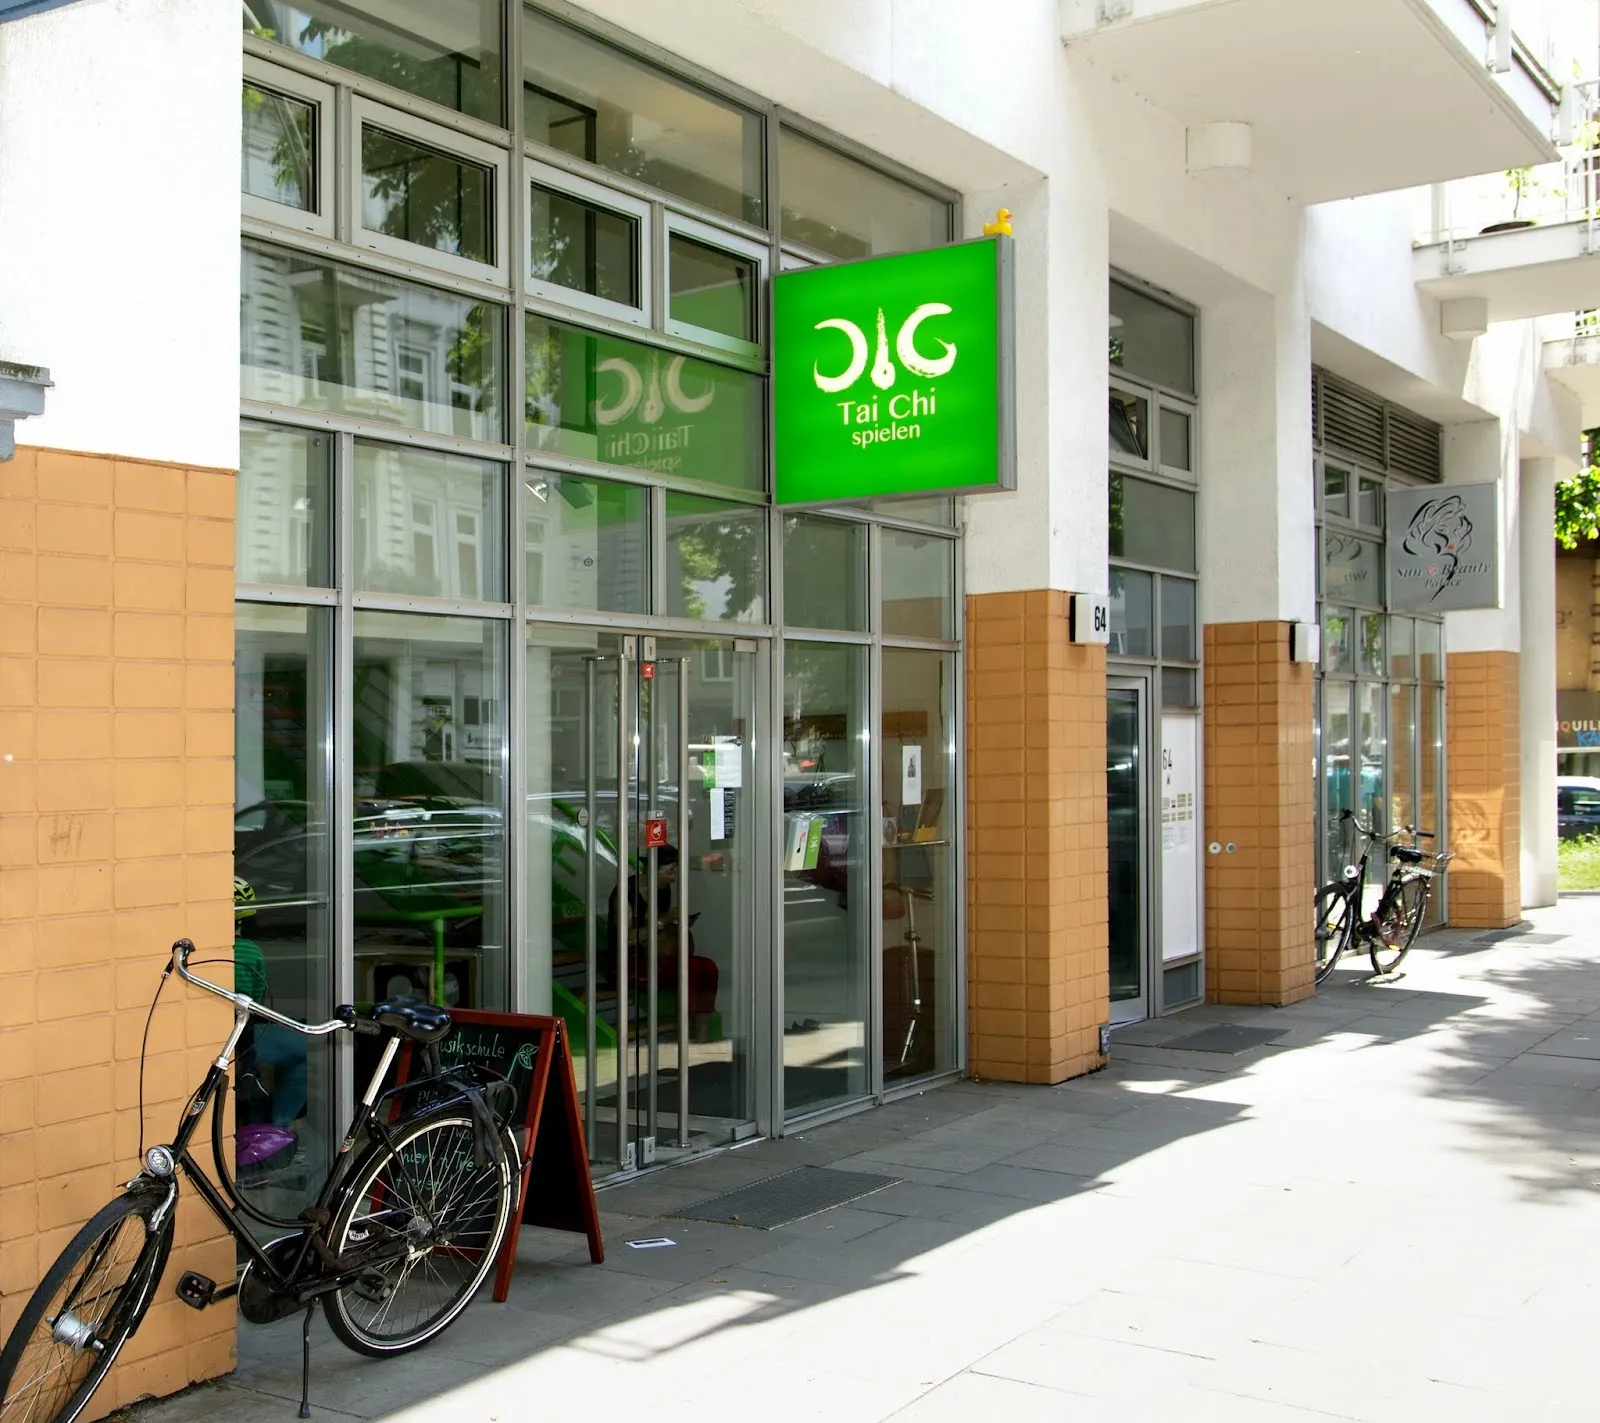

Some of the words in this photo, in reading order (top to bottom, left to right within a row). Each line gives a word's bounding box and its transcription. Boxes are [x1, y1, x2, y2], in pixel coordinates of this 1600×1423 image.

[837, 395, 878, 425] Tai
[888, 387, 936, 419] Chi
[851, 422, 921, 449] spielen
[1094, 605, 1107, 632] 64
[1557, 719, 1600, 735] QUIL
[438, 1031, 506, 1059] usikschule
